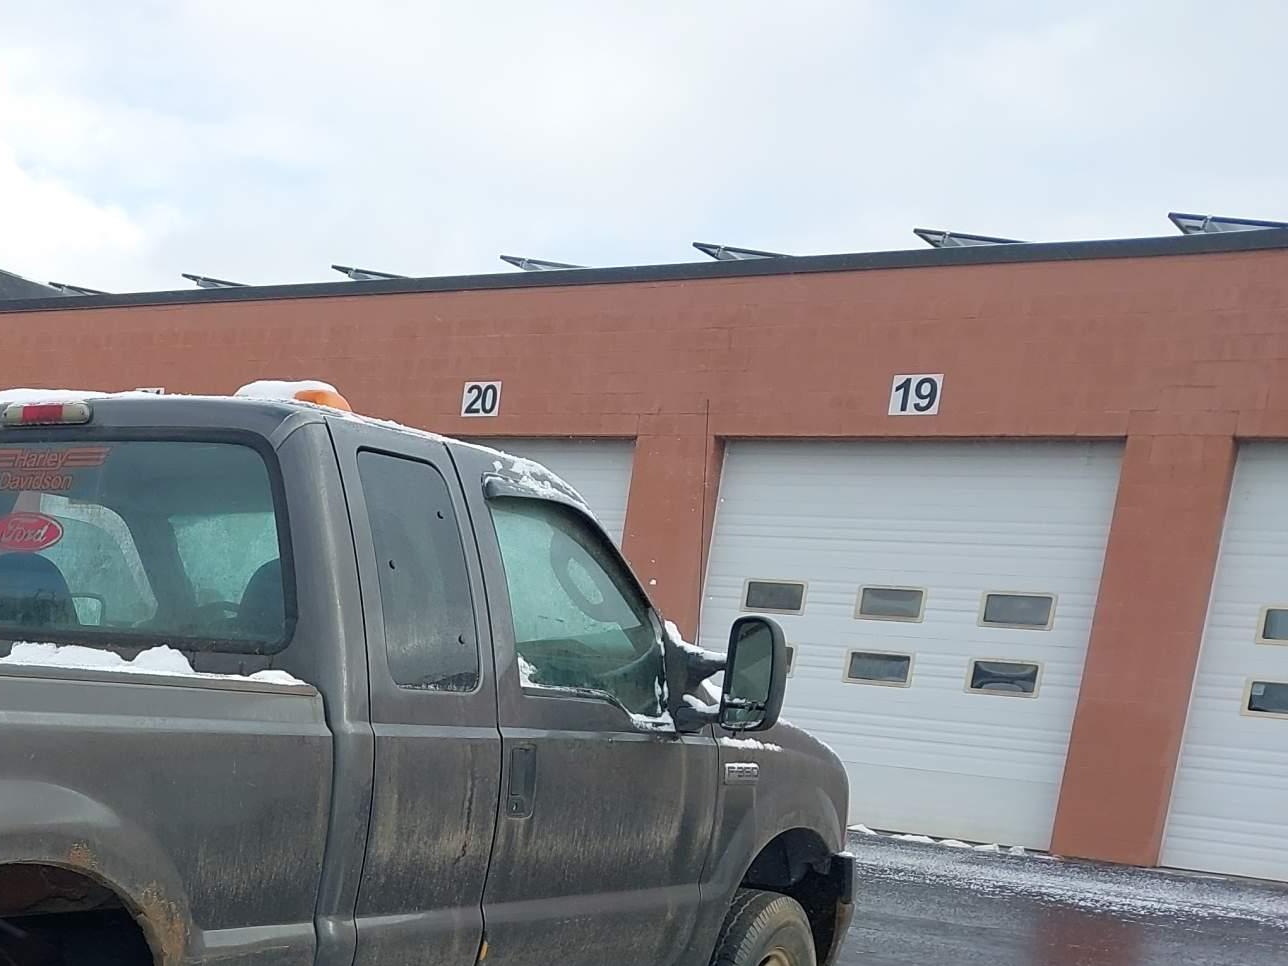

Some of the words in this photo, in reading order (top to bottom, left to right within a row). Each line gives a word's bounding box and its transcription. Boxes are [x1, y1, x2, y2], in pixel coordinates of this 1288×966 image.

[464, 384, 497, 414] 20
[894, 376, 937, 412] 19
[14, 450, 67, 470] Harley
[0, 518, 50, 544] Ford
